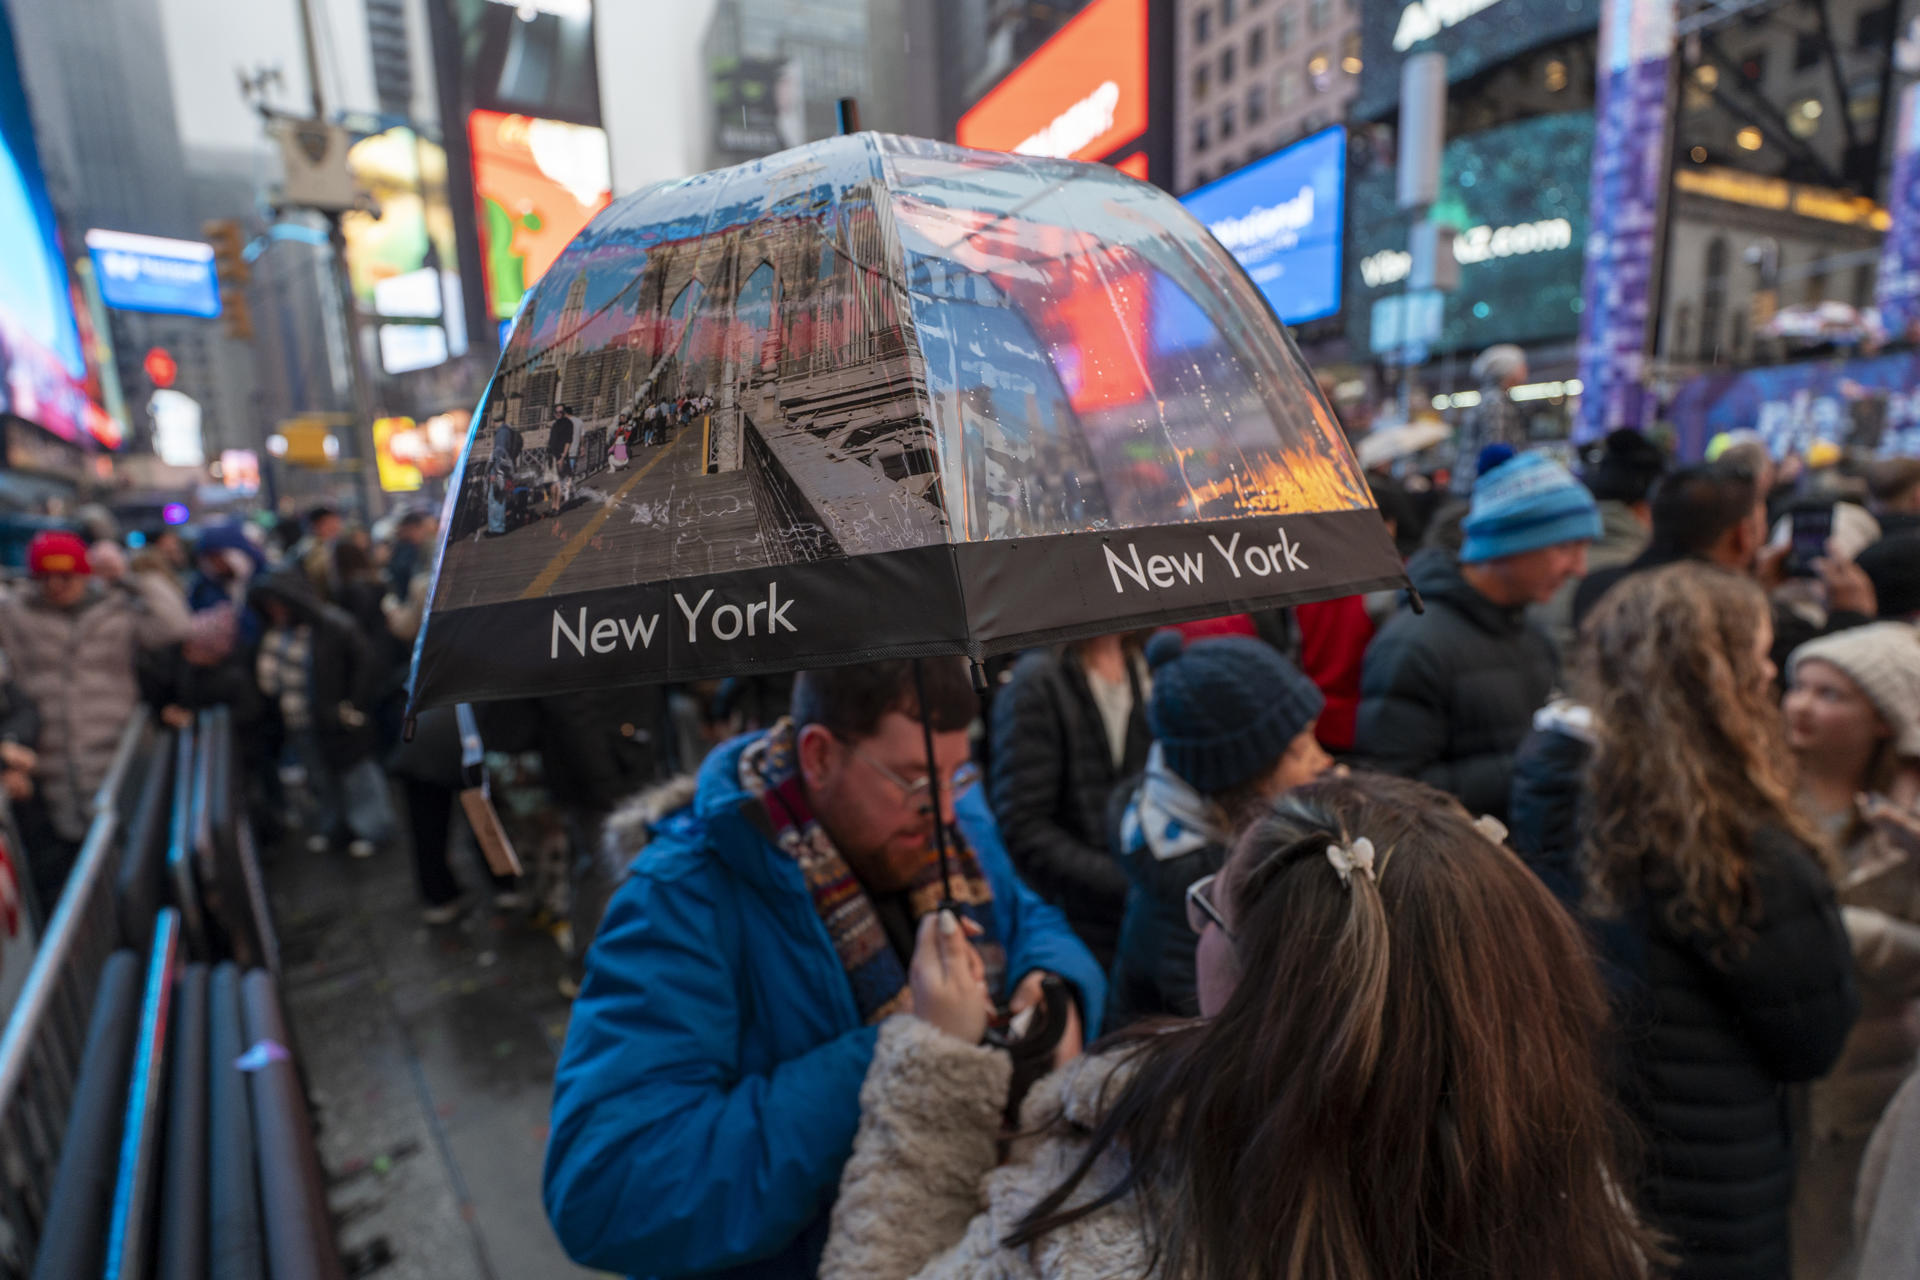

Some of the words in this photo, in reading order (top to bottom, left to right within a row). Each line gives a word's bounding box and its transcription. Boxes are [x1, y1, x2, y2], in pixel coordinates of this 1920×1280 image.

[1102, 543, 1203, 593] New
[1208, 527, 1309, 578] York
[551, 606, 659, 659] New
[674, 582, 797, 643] York
